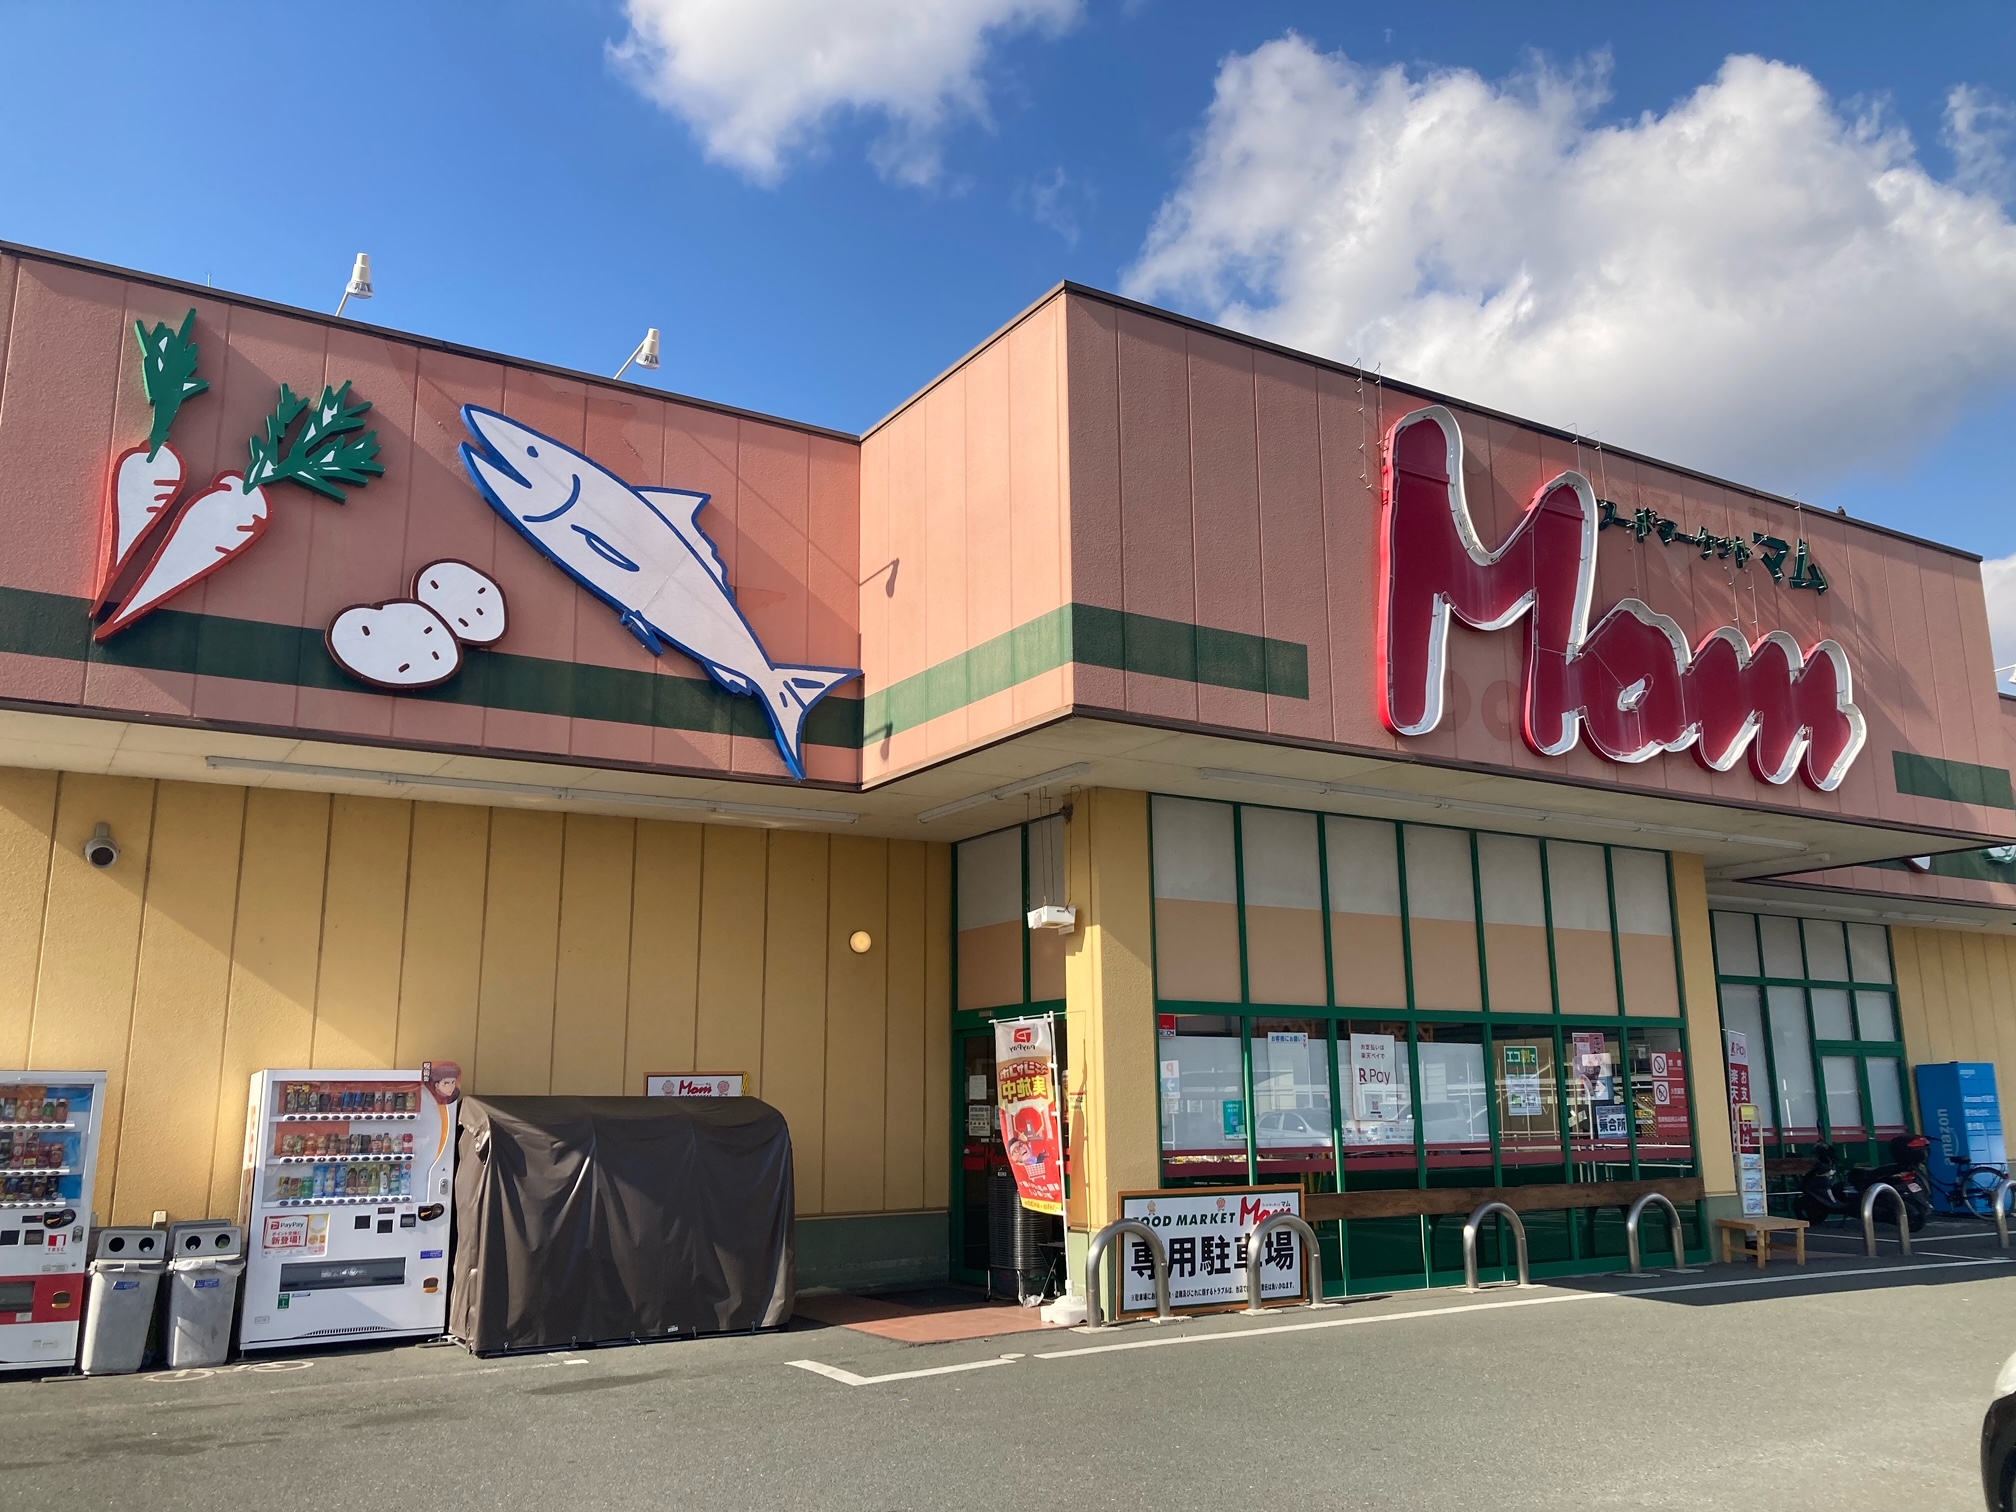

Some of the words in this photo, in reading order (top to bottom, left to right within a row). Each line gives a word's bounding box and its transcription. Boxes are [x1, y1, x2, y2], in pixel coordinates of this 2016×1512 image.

[1379, 405, 1866, 791] Mom
[1369, 1068, 1391, 1085] Pay
[678, 1079, 713, 1095] Mom
[1937, 1108, 1954, 1166] amazon
[281, 1221, 305, 1229] PayPay
[1176, 1212, 1236, 1227] MARKET
